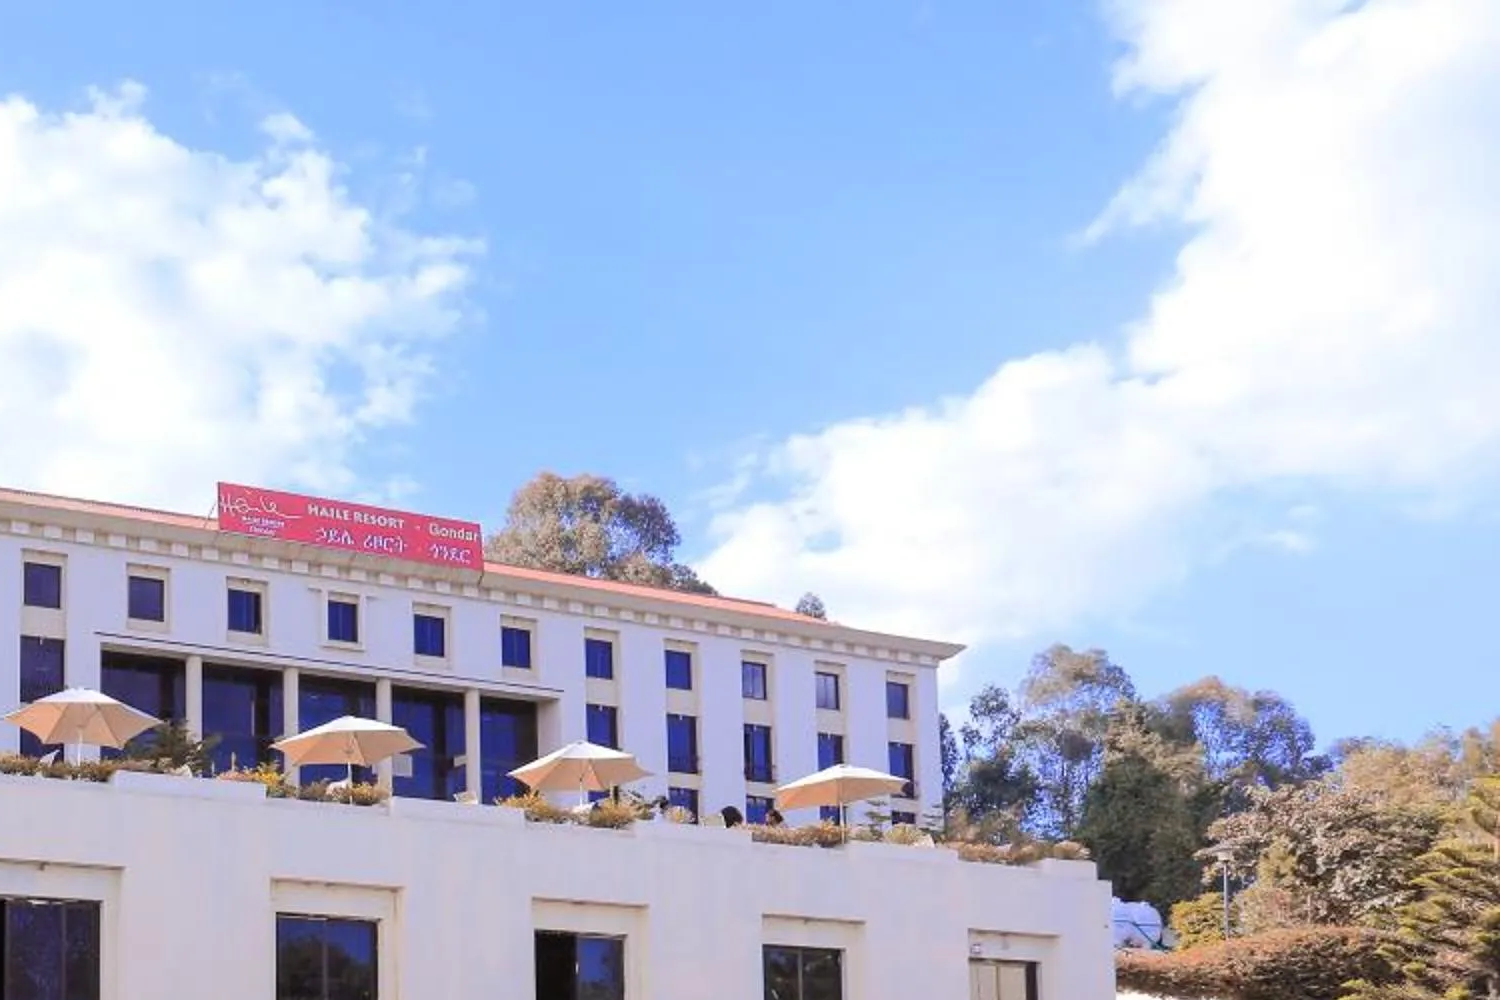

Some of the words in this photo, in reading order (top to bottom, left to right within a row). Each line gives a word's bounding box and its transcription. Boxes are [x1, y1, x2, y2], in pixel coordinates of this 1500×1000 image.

[307, 503, 352, 521] HAILE
[353, 511, 405, 529] RESORT
[429, 523, 477, 542] Gondar
